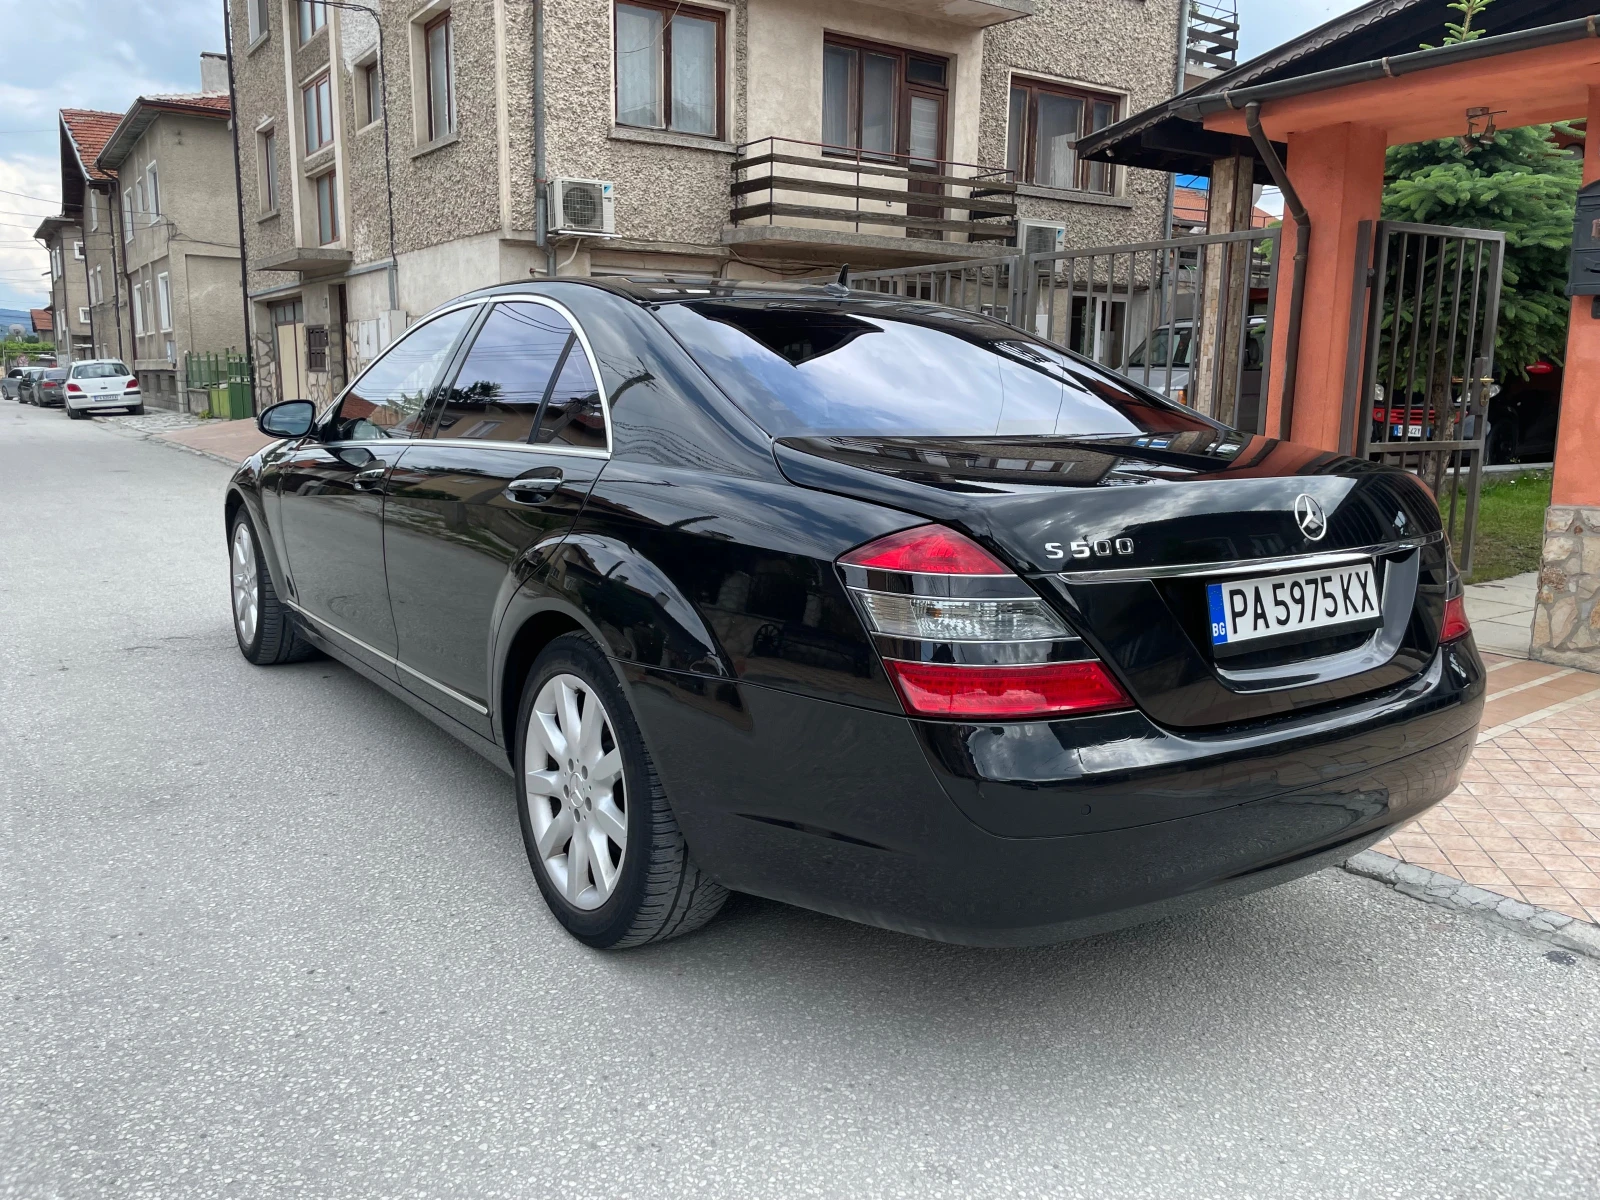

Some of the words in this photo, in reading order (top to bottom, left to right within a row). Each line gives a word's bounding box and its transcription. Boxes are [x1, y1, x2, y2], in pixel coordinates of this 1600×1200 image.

[1044, 542, 1064, 559] S
[1070, 537, 1135, 558] 500
[1212, 623, 1226, 637] BG
